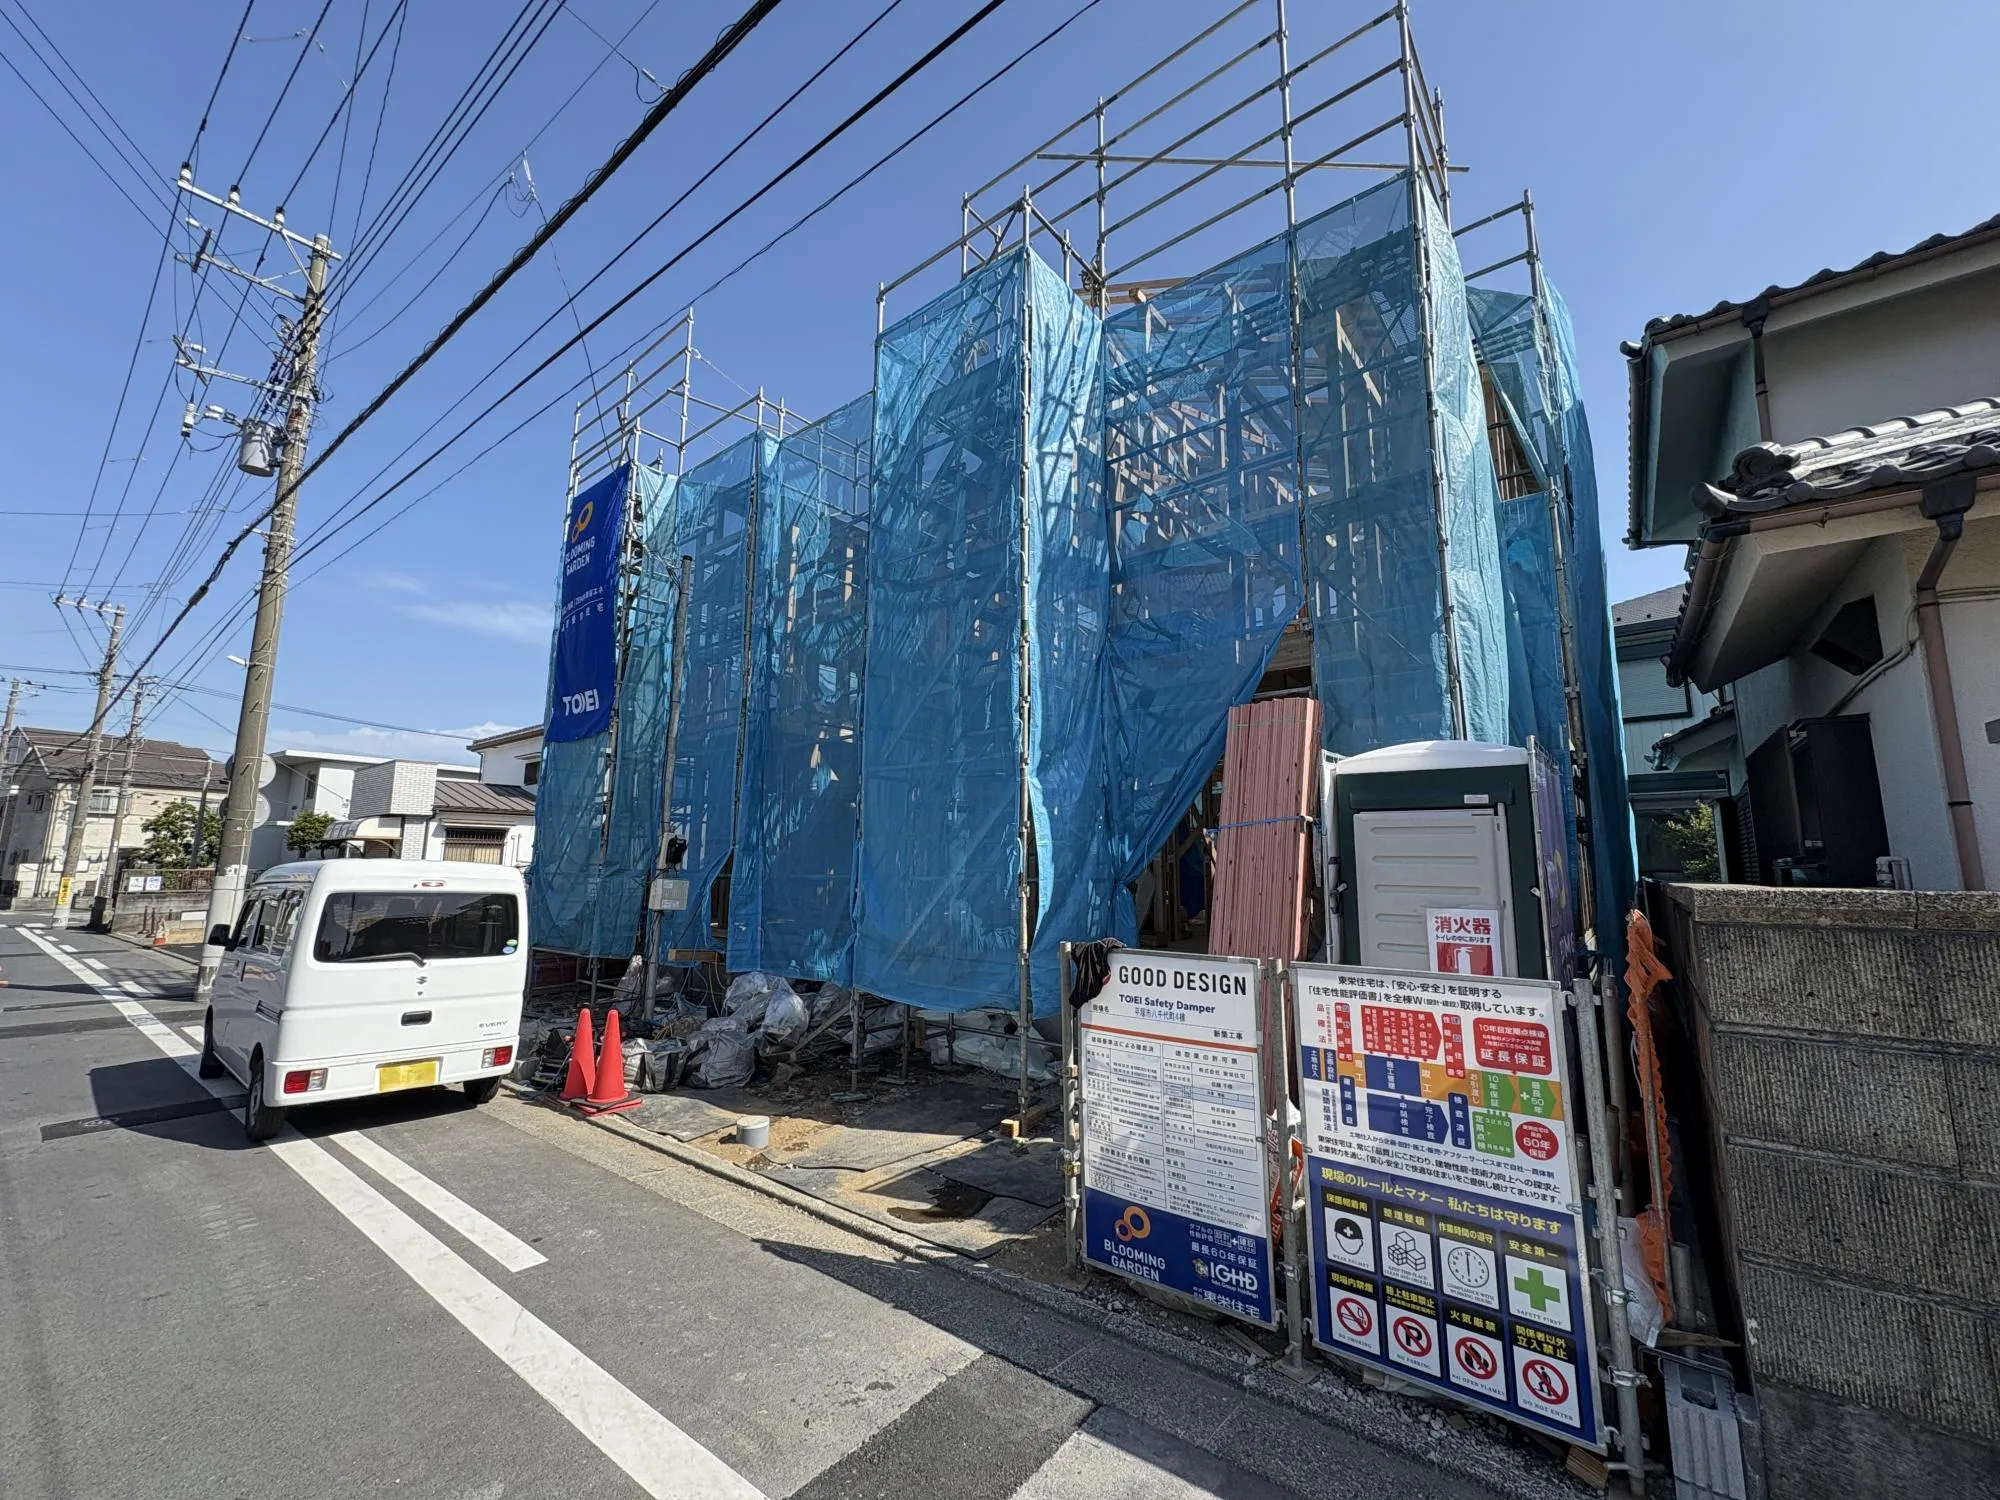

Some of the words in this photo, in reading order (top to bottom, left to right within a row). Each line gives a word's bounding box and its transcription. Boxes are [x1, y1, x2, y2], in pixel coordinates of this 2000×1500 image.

[565, 535, 596, 565] BLOOMING
[566, 551, 591, 577] GARDEN
[1434, 915, 1491, 936] 消火器
[1435, 934, 1491, 944] トイレの中にあります
[1118, 965, 1167, 988] GOOD
[1173, 971, 1247, 996] DESIGN
[1338, 976, 1502, 999] 東栄住宅は、「安心・安全」を証明する
[1144, 997, 1174, 1011] Safety
[1176, 1001, 1216, 1015] Damper
[1213, 1029, 1244, 1041] 新築工事
[1311, 1050, 1320, 1078] 土地仕入
[1480, 1048, 1547, 1068] 延長保証
[1386, 1060, 1396, 1090] 施工管理
[1342, 1077, 1353, 1125] 確認済証
[1469, 1073, 1480, 1104] お引渡し
[1487, 1075, 1500, 1108] 10年保証
[1321, 1088, 1333, 1132] 建築基準法
[1400, 1102, 1409, 1135] 中間検査
[1453, 1095, 1466, 1147] 検査済証
[1424, 1106, 1435, 1140] 完了検査
[1474, 1114, 1486, 1151] 定期点検
[1523, 1138, 1551, 1151] 60年
[1528, 1148, 1547, 1159] 保証
[1321, 1166, 1444, 1203] 現場のルールとマナー
[1447, 1196, 1562, 1235] 私たちは守ります
[1326, 1193, 1368, 1212] 保護帽着用
[1383, 1207, 1425, 1227] 整理整頓
[1438, 1221, 1493, 1245] 作業時間の遵守
[1103, 1239, 1166, 1270] BLOOMING
[1191, 1241, 1258, 1270] 最長60年保証
[1508, 1239, 1559, 1258] 安全第一
[1110, 1254, 1160, 1283] GARDEN
[1331, 1272, 1374, 1294] 現場内禁煙
[1203, 1289, 1260, 1319] 東栄住宅
[1385, 1284, 1435, 1309] 路上駐車禁止
[1449, 1309, 1496, 1332] 火気厳禁
[1516, 1308, 1541, 1320] SAFETY
[1542, 1315, 1562, 1326] FIRST
[1515, 1324, 1567, 1349] 関係者以外
[1517, 1335, 1568, 1360] 立入禁止
[1462, 1377, 1480, 1387] OPEN
[1534, 1402, 1548, 1412] NOT
[1550, 1406, 1574, 1421] ENTER
